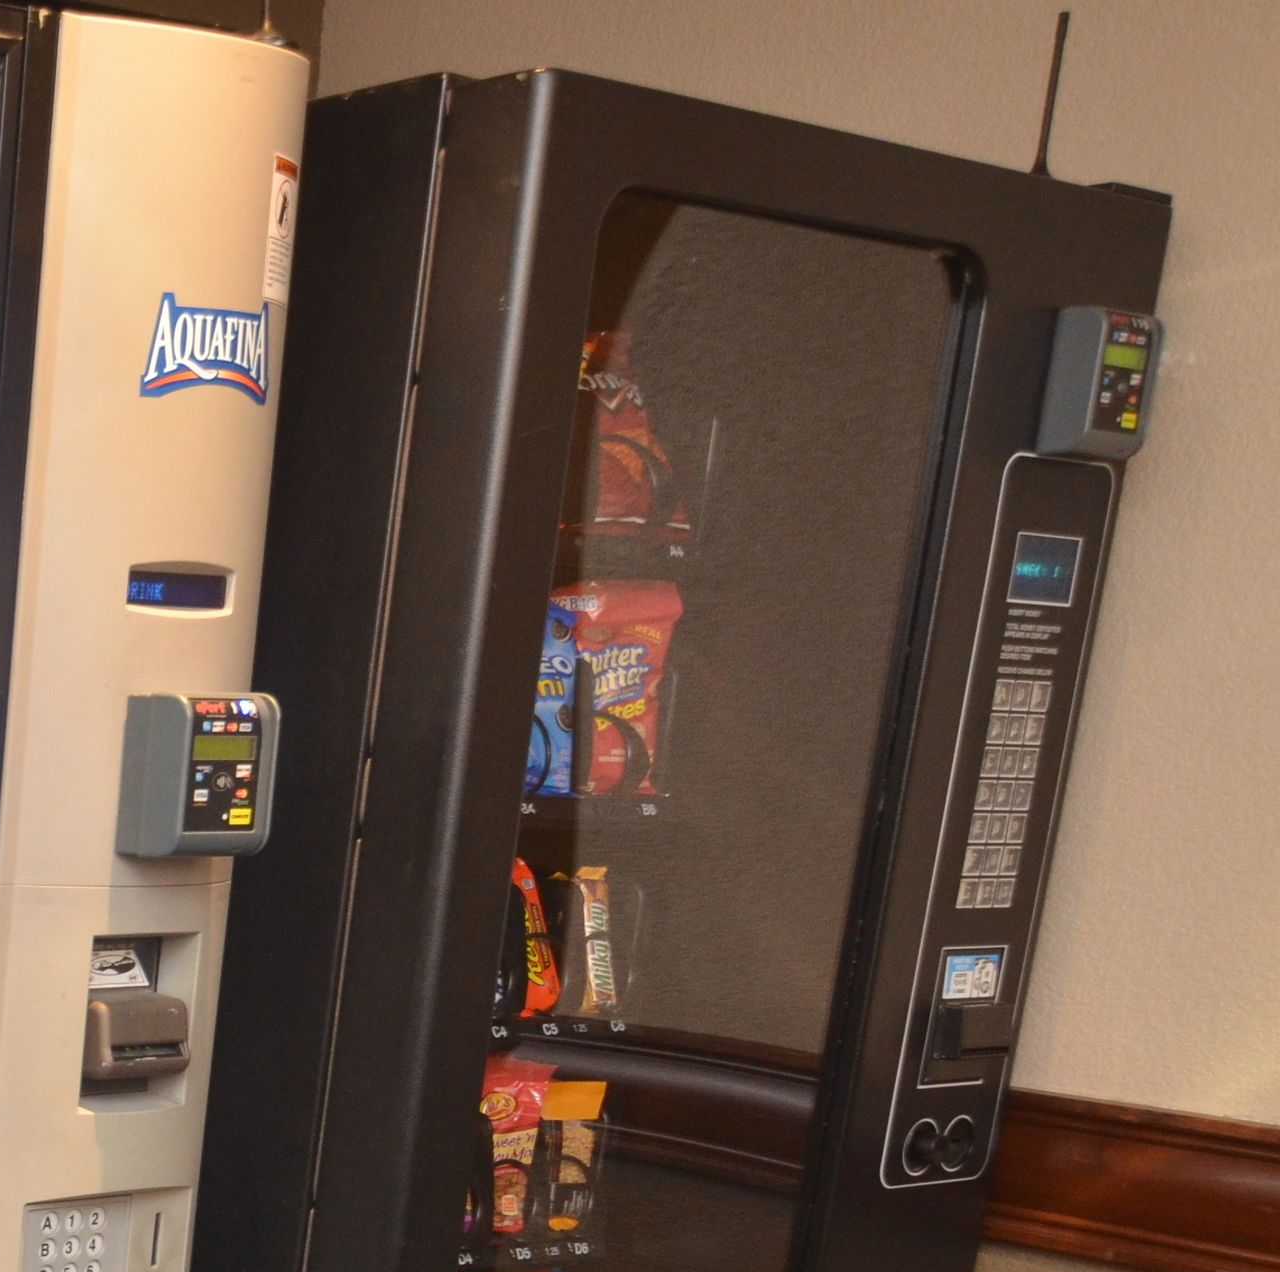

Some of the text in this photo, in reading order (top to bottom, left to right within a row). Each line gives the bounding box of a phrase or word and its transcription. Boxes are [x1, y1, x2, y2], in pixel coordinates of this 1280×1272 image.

[143, 299, 267, 391] AQUAFINA
[127, 579, 165, 601] RINK
[591, 941, 615, 995] Milky
[491, 1025, 508, 1039] C4
[542, 1022, 559, 1036] C5
[42, 1216, 52, 1230] A
[69, 1215, 75, 1228] 1
[91, 1212, 99, 1226] 2
[40, 1243, 49, 1257] B
[65, 1241, 73, 1254] 3
[88, 1238, 96, 1251] 4
[574, 1242, 589, 1255] D6
[516, 1247, 532, 1260] D5
